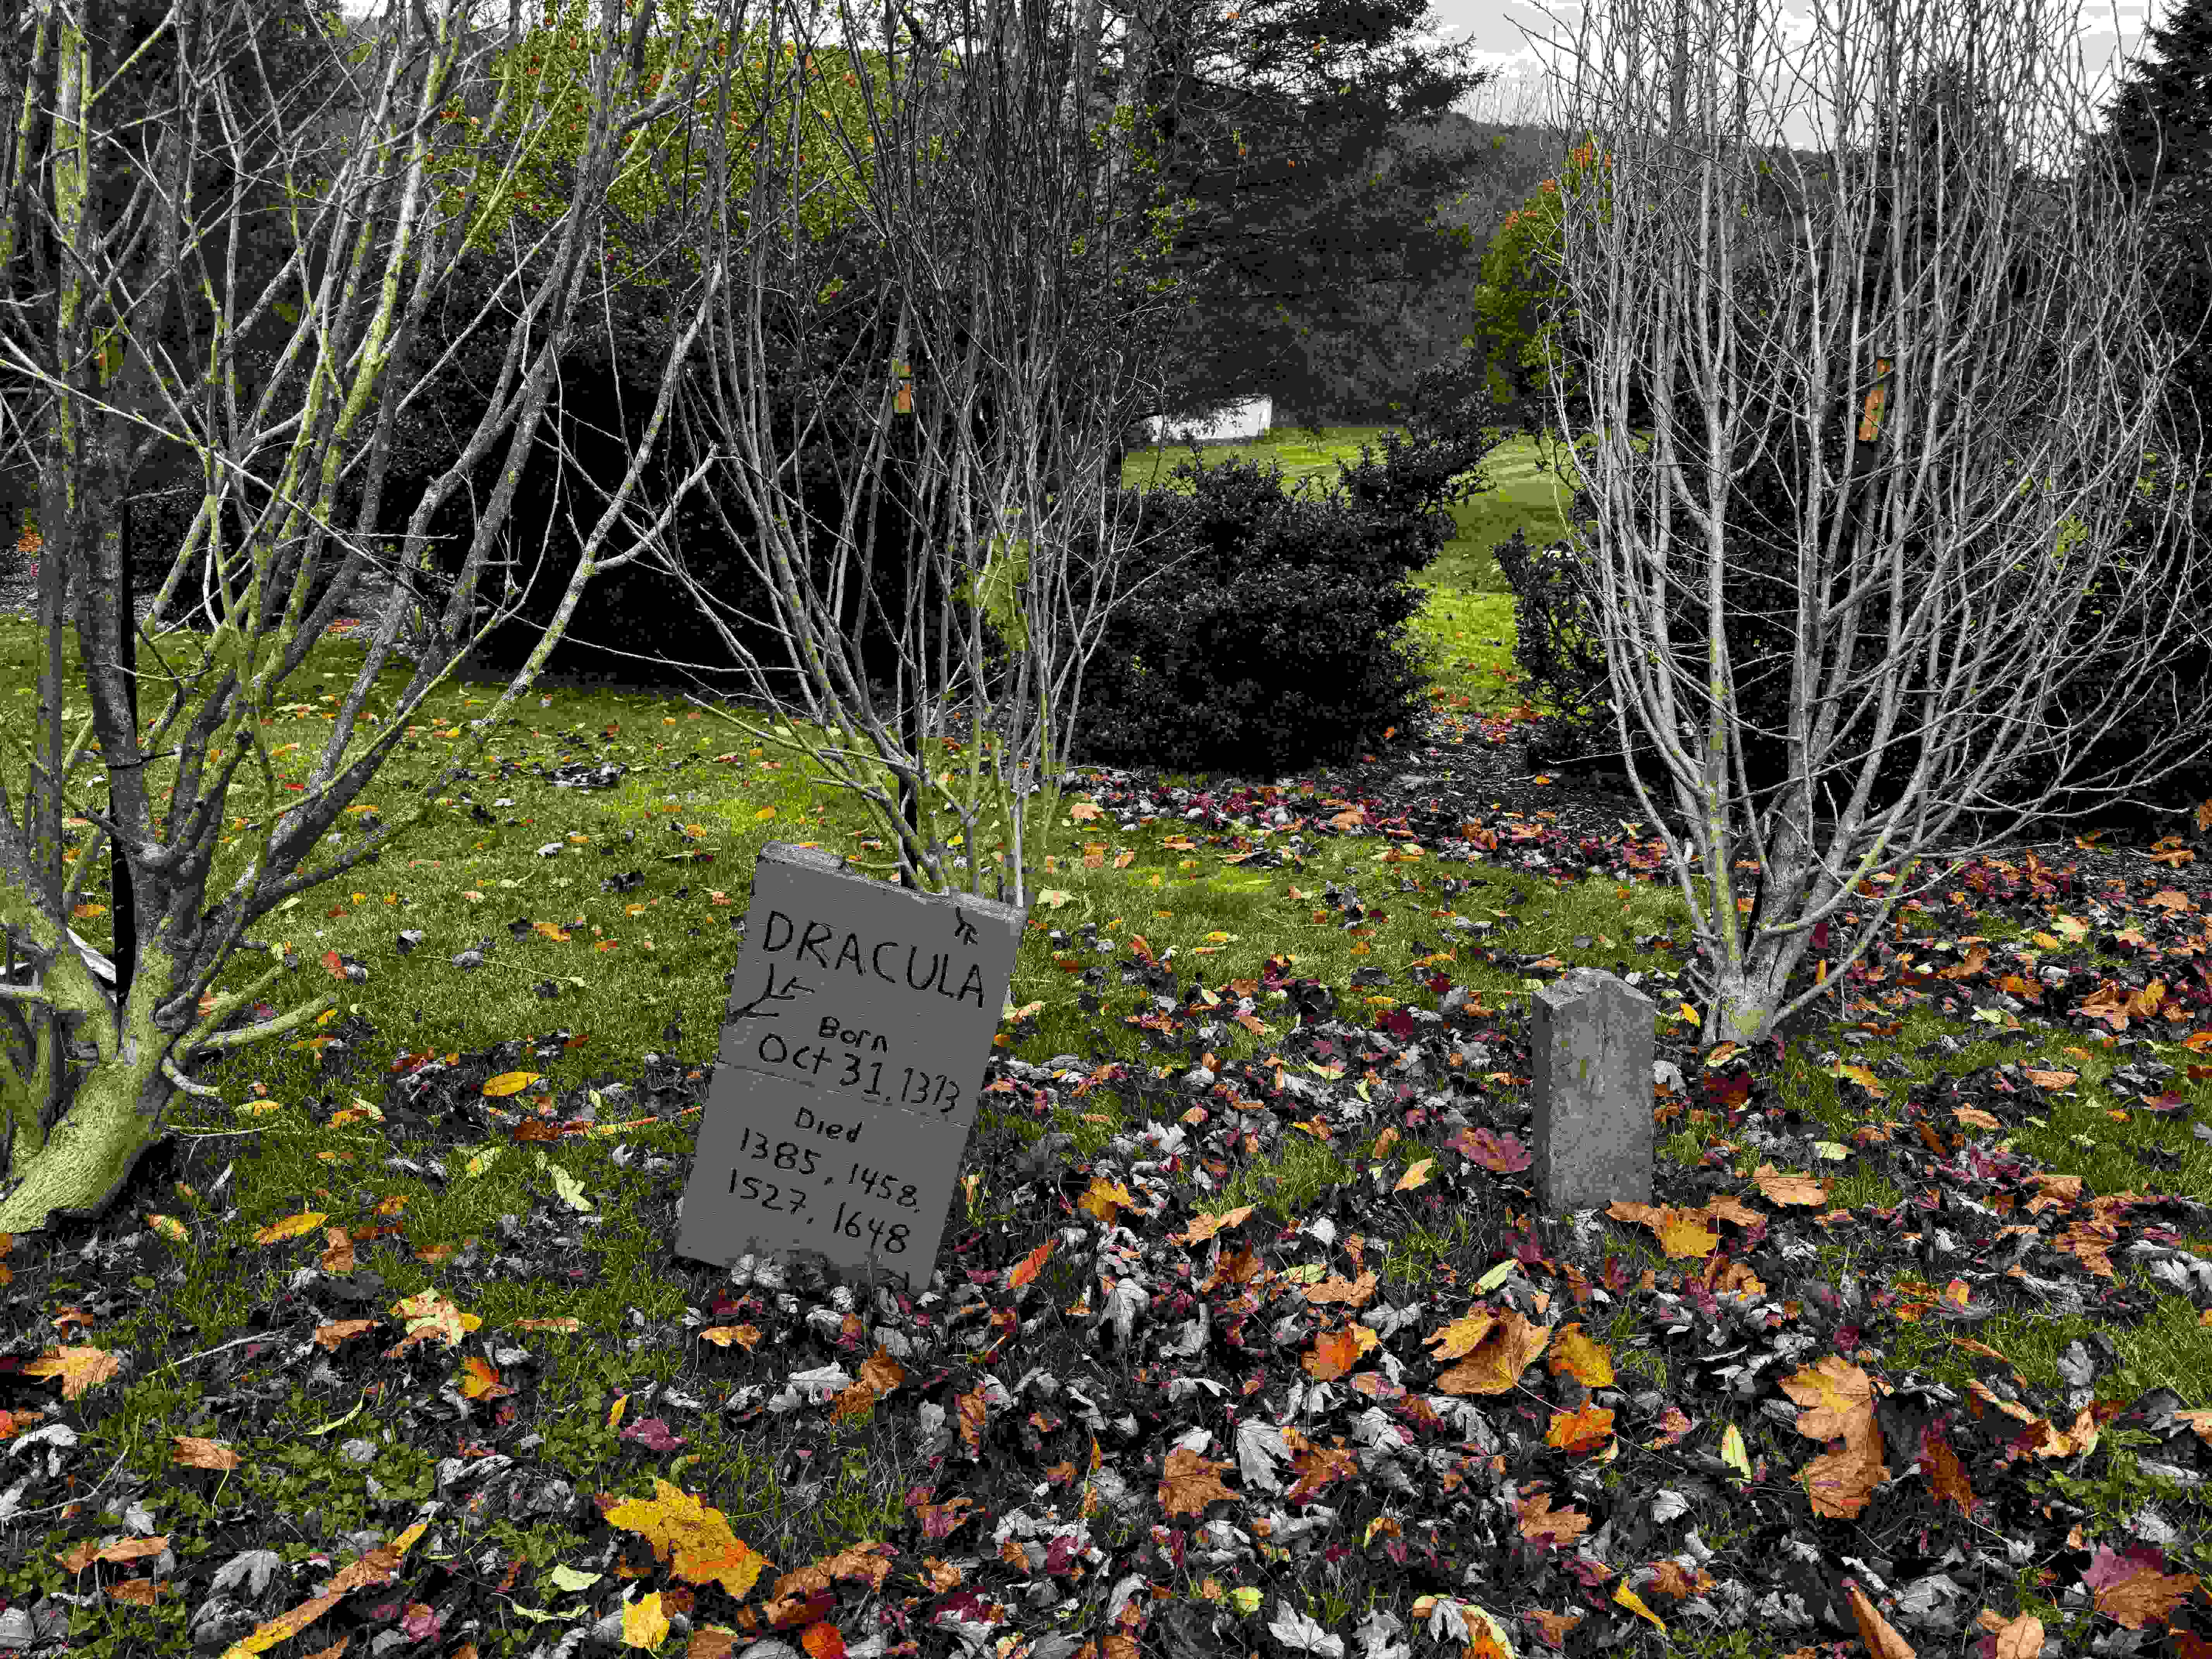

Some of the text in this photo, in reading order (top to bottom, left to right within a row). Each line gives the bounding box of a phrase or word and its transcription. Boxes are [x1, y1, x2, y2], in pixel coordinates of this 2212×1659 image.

[762, 910, 985, 1009] DRACULA
[759, 1033, 833, 1075] Oct
[818, 1016, 888, 1054] Born
[794, 1106, 863, 1143] Died
[833, 1202, 911, 1254] 1648
